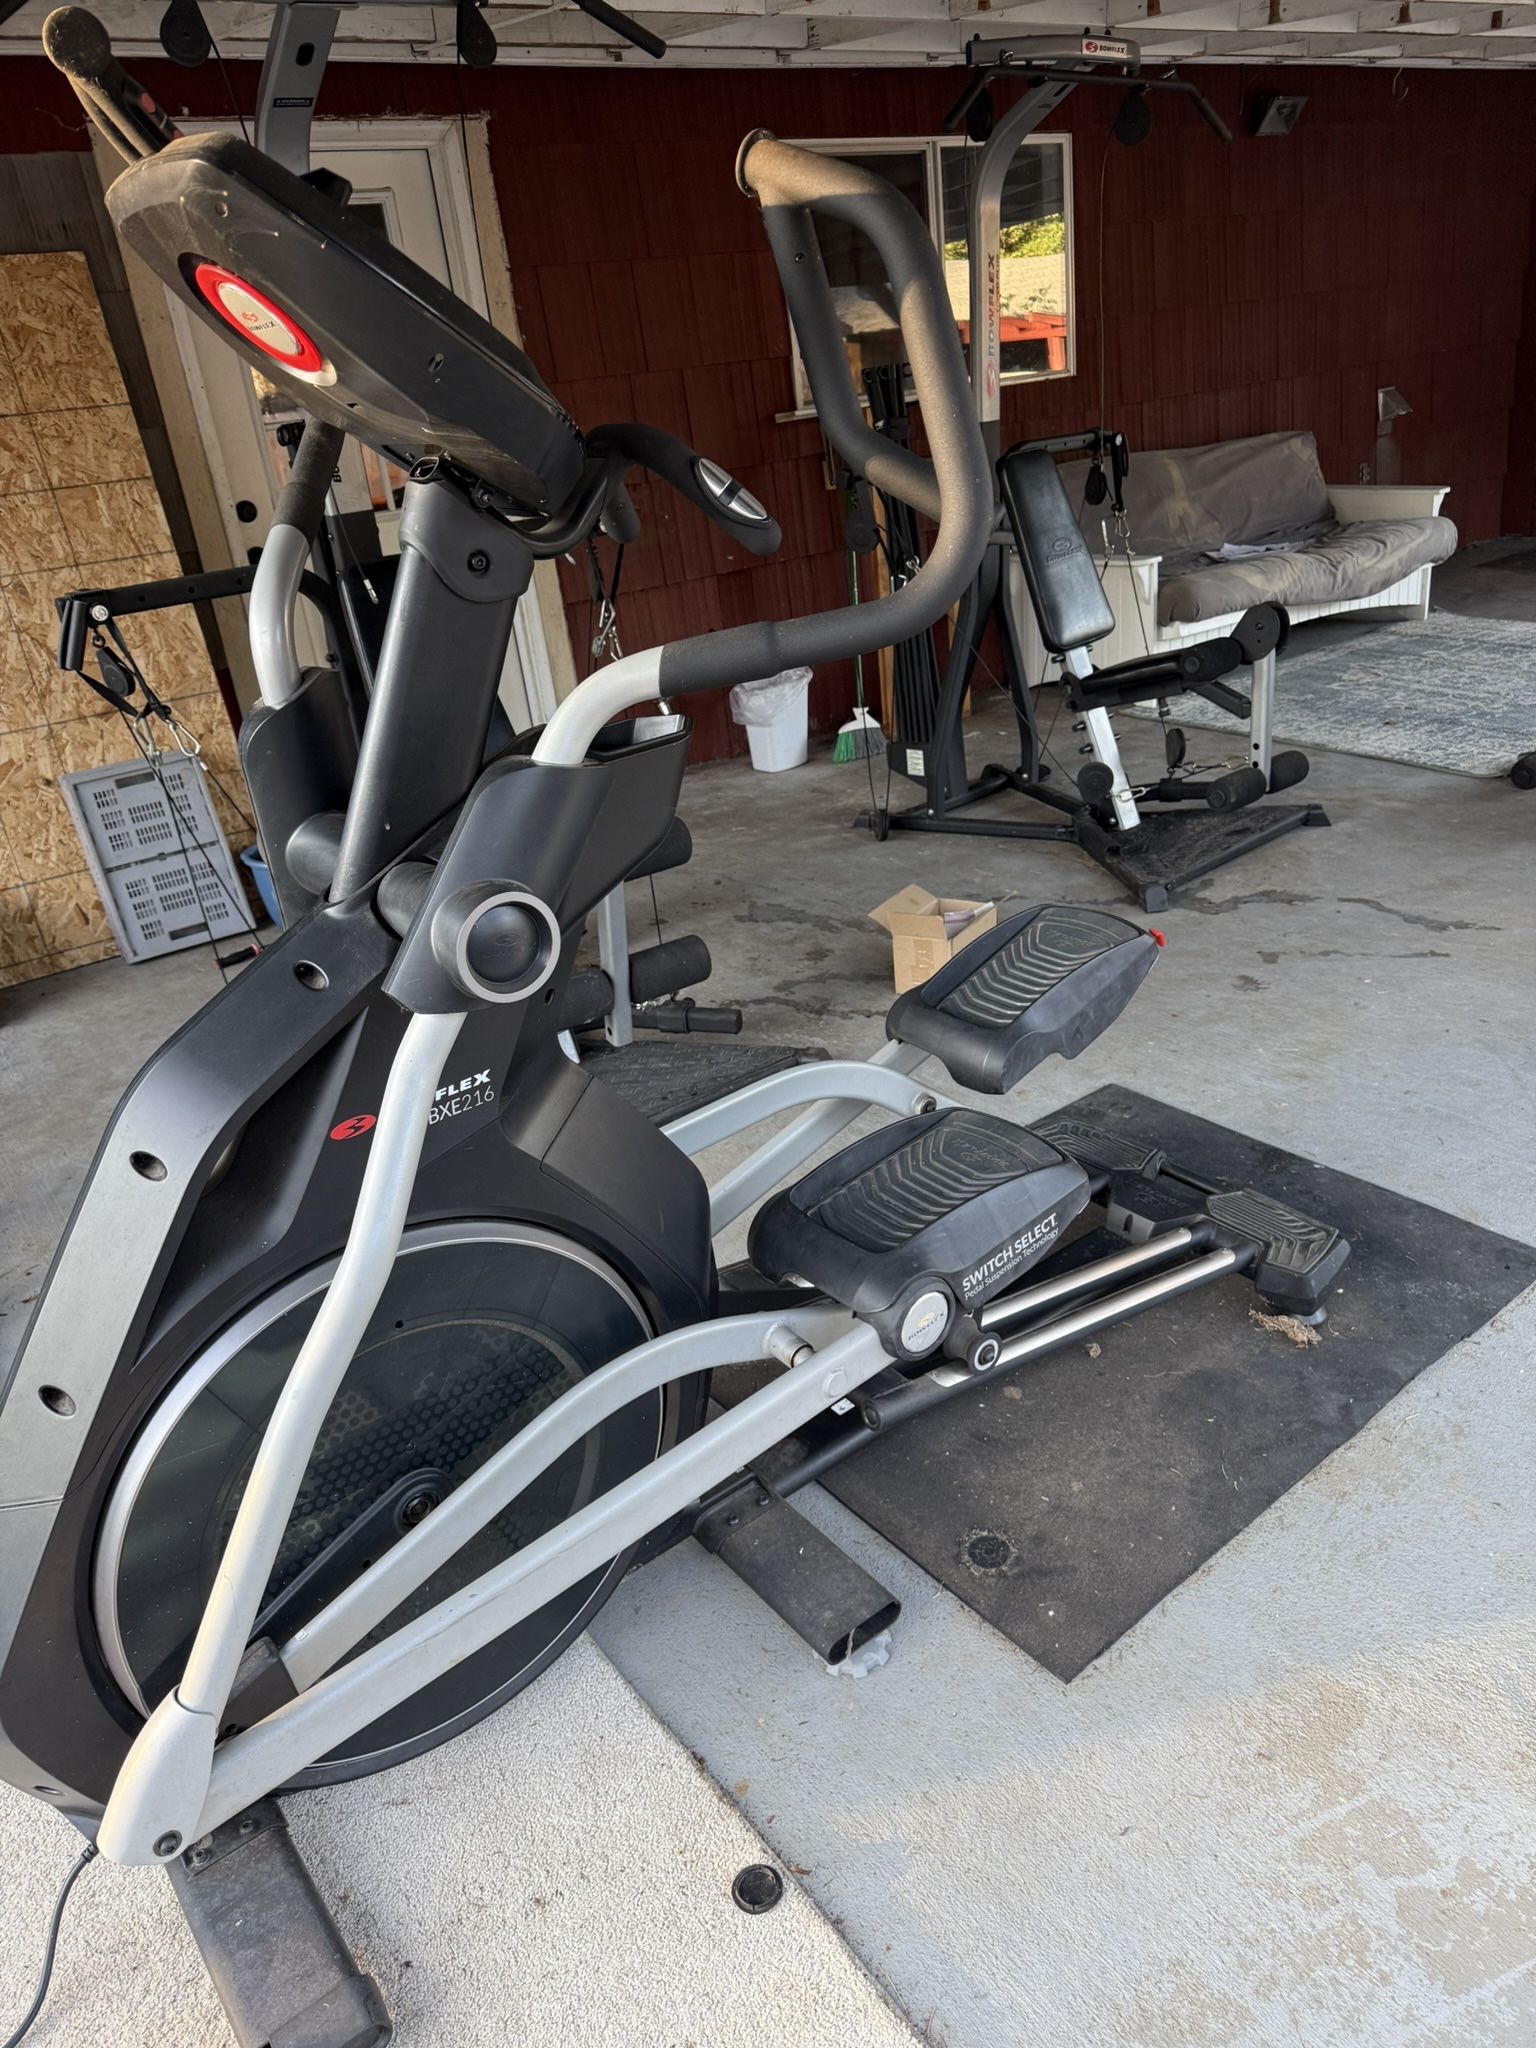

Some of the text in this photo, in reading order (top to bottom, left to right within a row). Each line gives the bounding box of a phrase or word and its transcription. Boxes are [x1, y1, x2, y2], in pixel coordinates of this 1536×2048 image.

[1099, 45, 1125, 53] BOWFLEX
[987, 252, 995, 357] BOWFLEX
[428, 1085, 495, 1126] BXE216
[435, 1069, 491, 1102] FLEX
[961, 1212, 1058, 1292] SWITCH SELECT
[964, 1227, 1060, 1301] Pedal Suspension Technology
